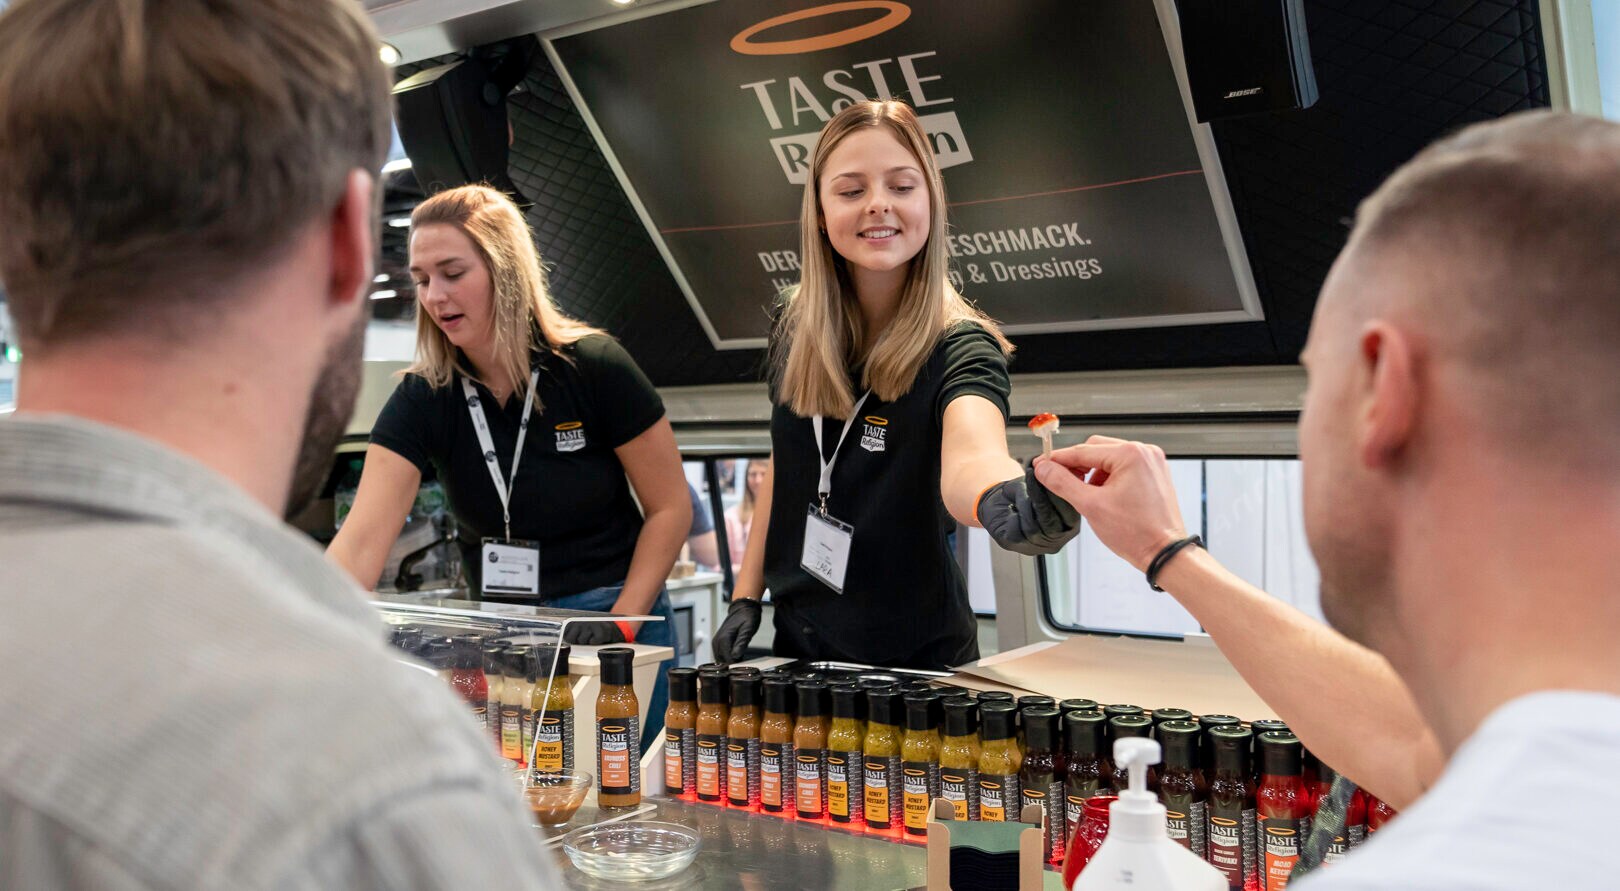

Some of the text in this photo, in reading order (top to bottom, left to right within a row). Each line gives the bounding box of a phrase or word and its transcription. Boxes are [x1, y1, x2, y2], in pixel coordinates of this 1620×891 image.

[740, 51, 954, 130] TASTE
[1224, 87, 1261, 99] BOSE
[757, 222, 1092, 272] DER ESCHMACK.
[967, 263, 988, 284] &
[989, 257, 1103, 283] Dressings
[554, 429, 585, 442] TASTE
[863, 424, 887, 440] TASTE
[862, 437, 884, 450] Religion
[538, 725, 561, 734] ASTE
[602, 733, 627, 742] TASTE
[797, 762, 819, 772] TASTE
[865, 769, 886, 779] TASTE
[904, 775, 927, 785] TASTE
[942, 781, 965, 792] TASTE
[980, 788, 1002, 799] TASTE
[1067, 802, 1082, 813] TAS
[1211, 823, 1239, 837] TASTE
[1266, 834, 1297, 846] TASTE
[1267, 845, 1297, 857] Religion
